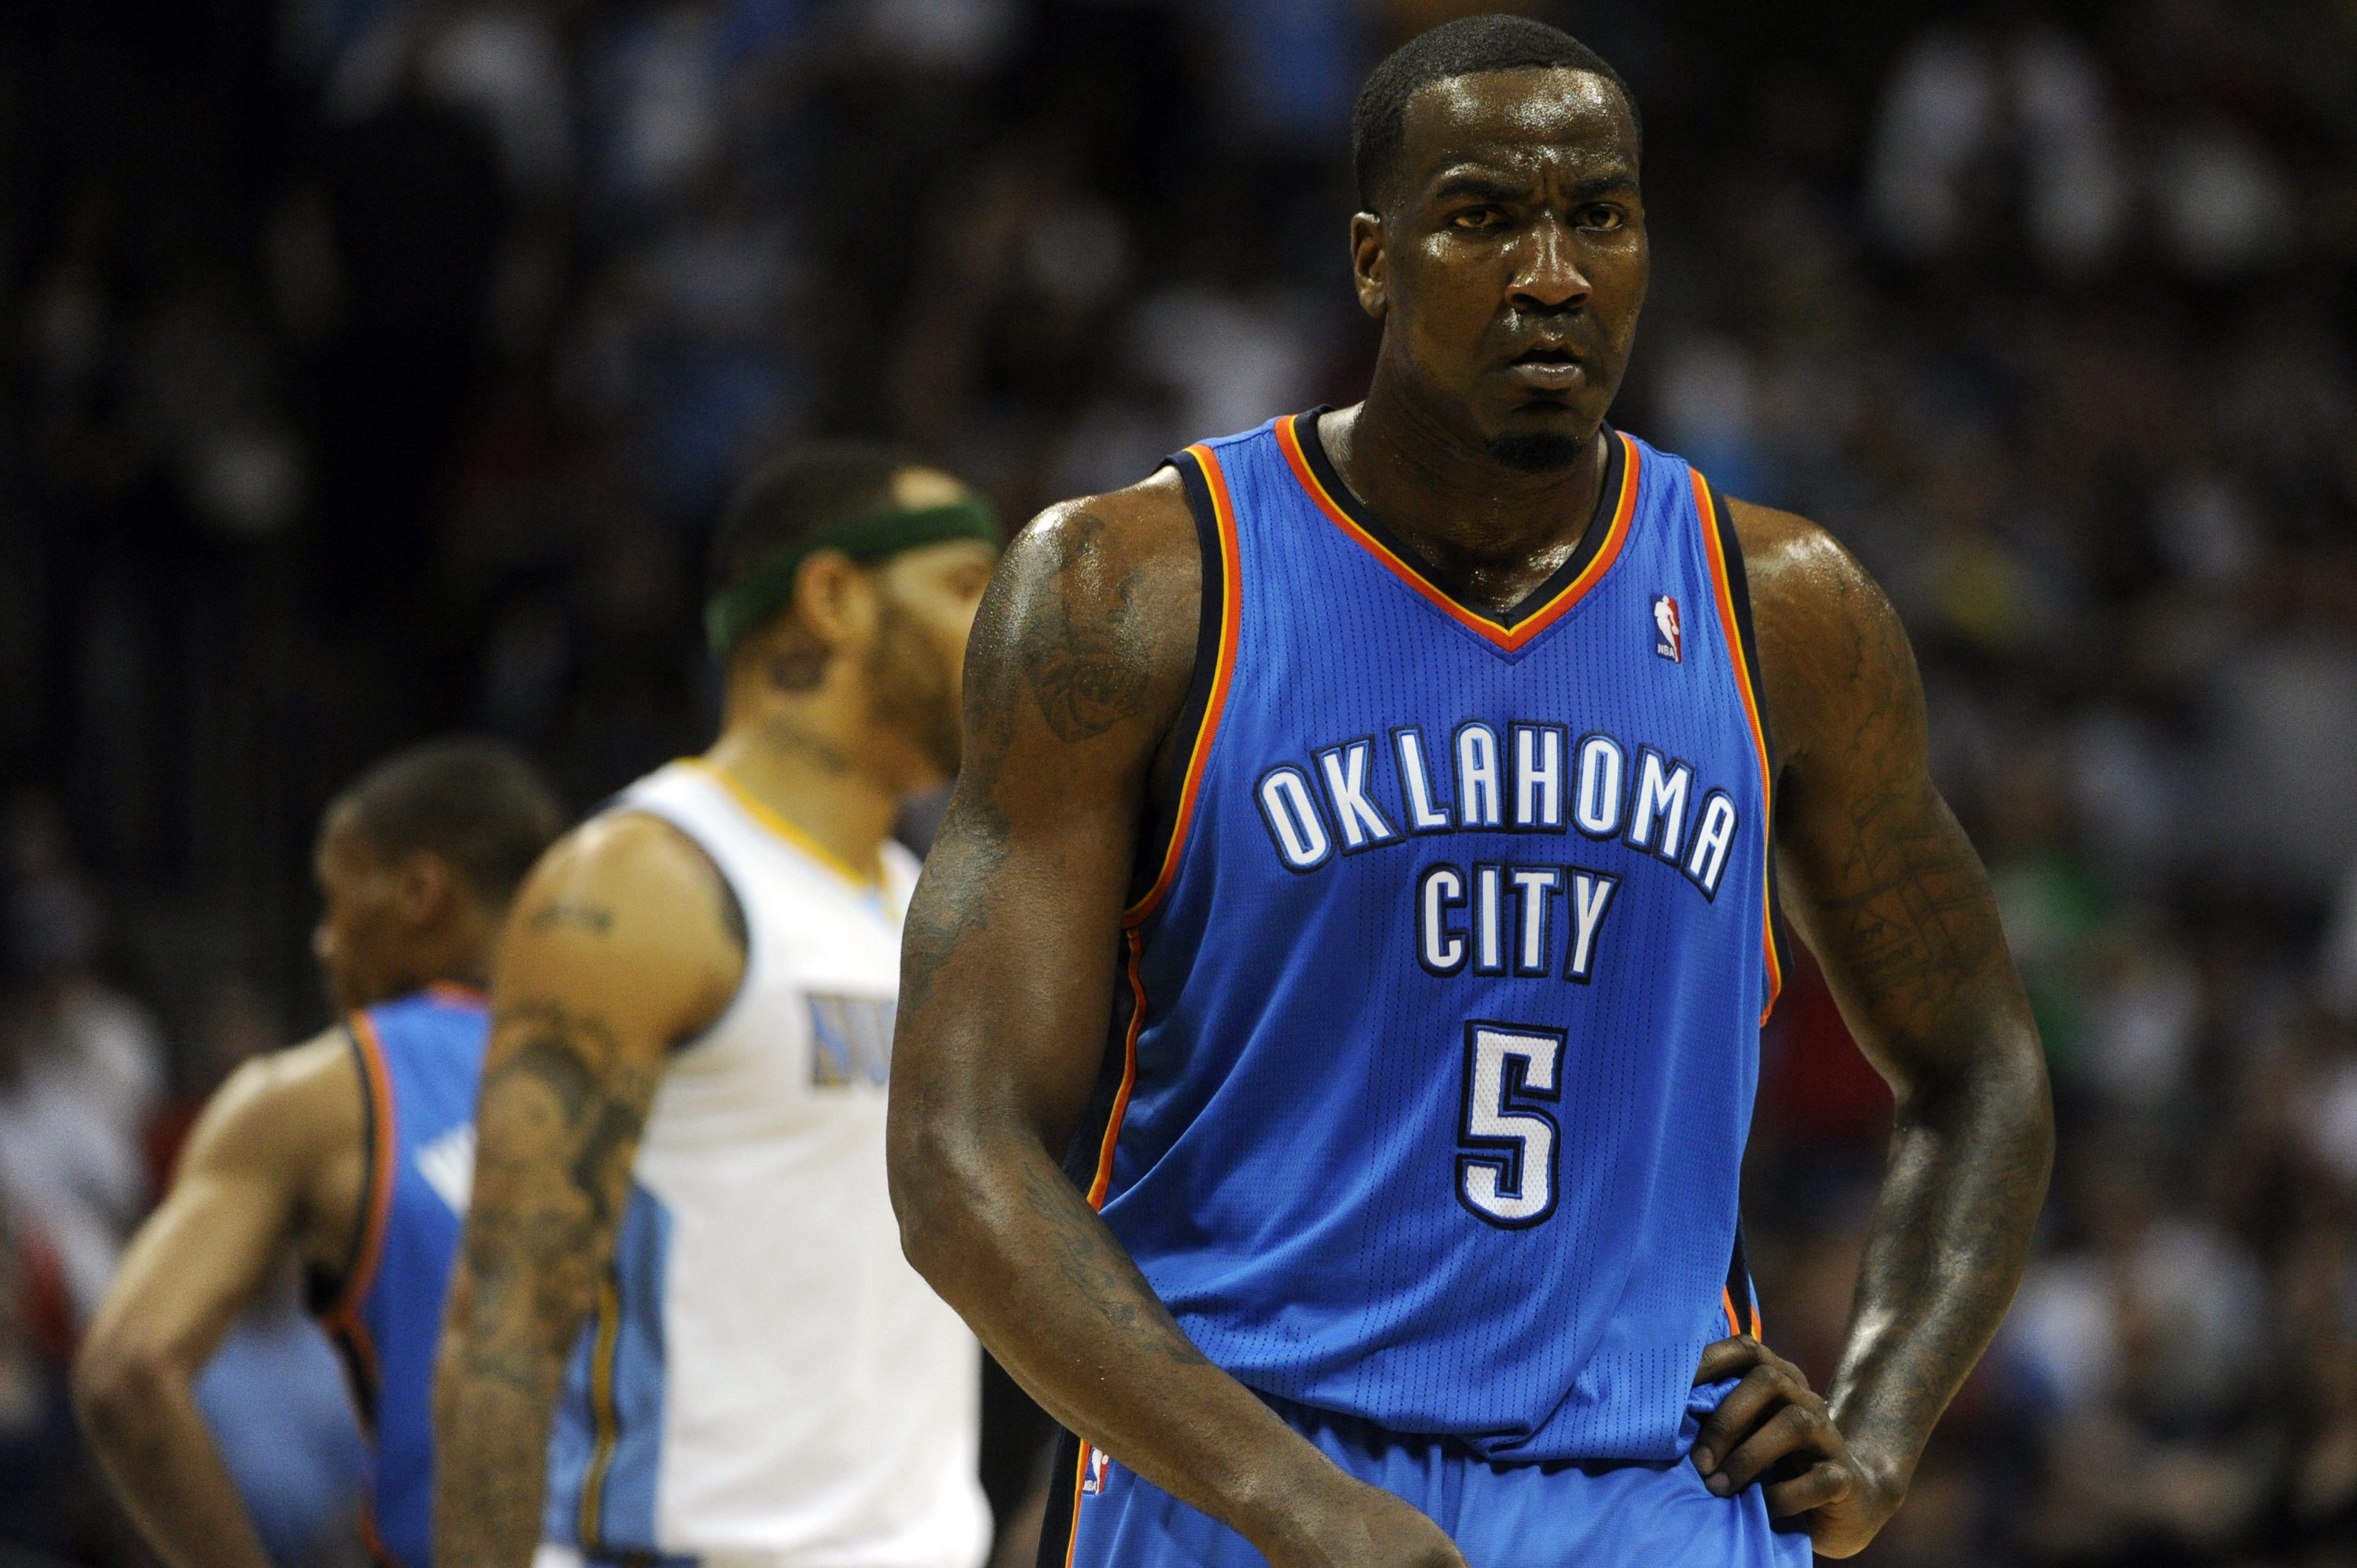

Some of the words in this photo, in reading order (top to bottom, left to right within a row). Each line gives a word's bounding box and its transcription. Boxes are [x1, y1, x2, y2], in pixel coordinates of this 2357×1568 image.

[1658, 643, 1675, 658] NBA
[1255, 719, 1738, 903] OKLAHOMA
[1418, 861, 1621, 984] CITY
[1455, 1019, 1568, 1229] 5
